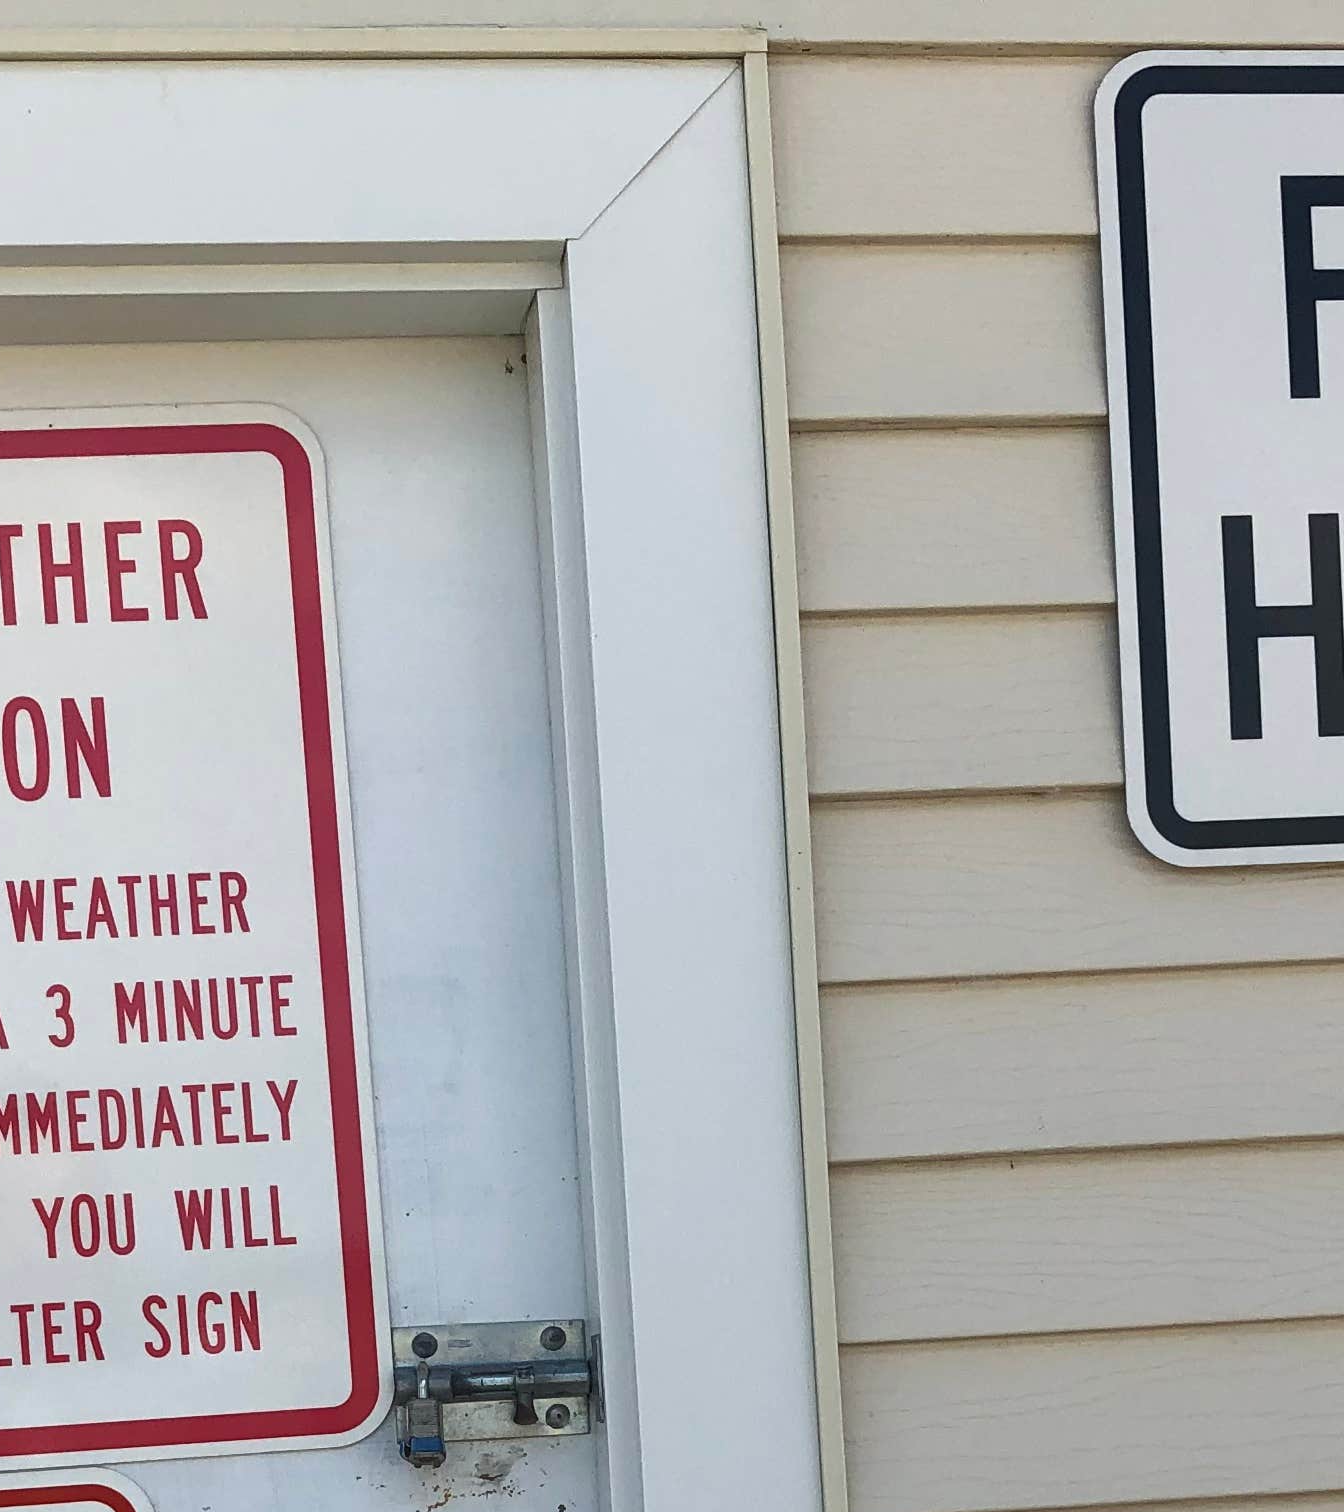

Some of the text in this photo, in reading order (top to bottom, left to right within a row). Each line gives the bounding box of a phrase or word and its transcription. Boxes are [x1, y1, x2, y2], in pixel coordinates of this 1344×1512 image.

[7, 872, 248, 941] WEATHER
[47, 985, 74, 1046] 3
[116, 976, 295, 1042] MINUTE
[34, 1194, 134, 1257] YOU
[176, 1188, 296, 1249] WILL
[143, 1293, 259, 1357] SIGN
